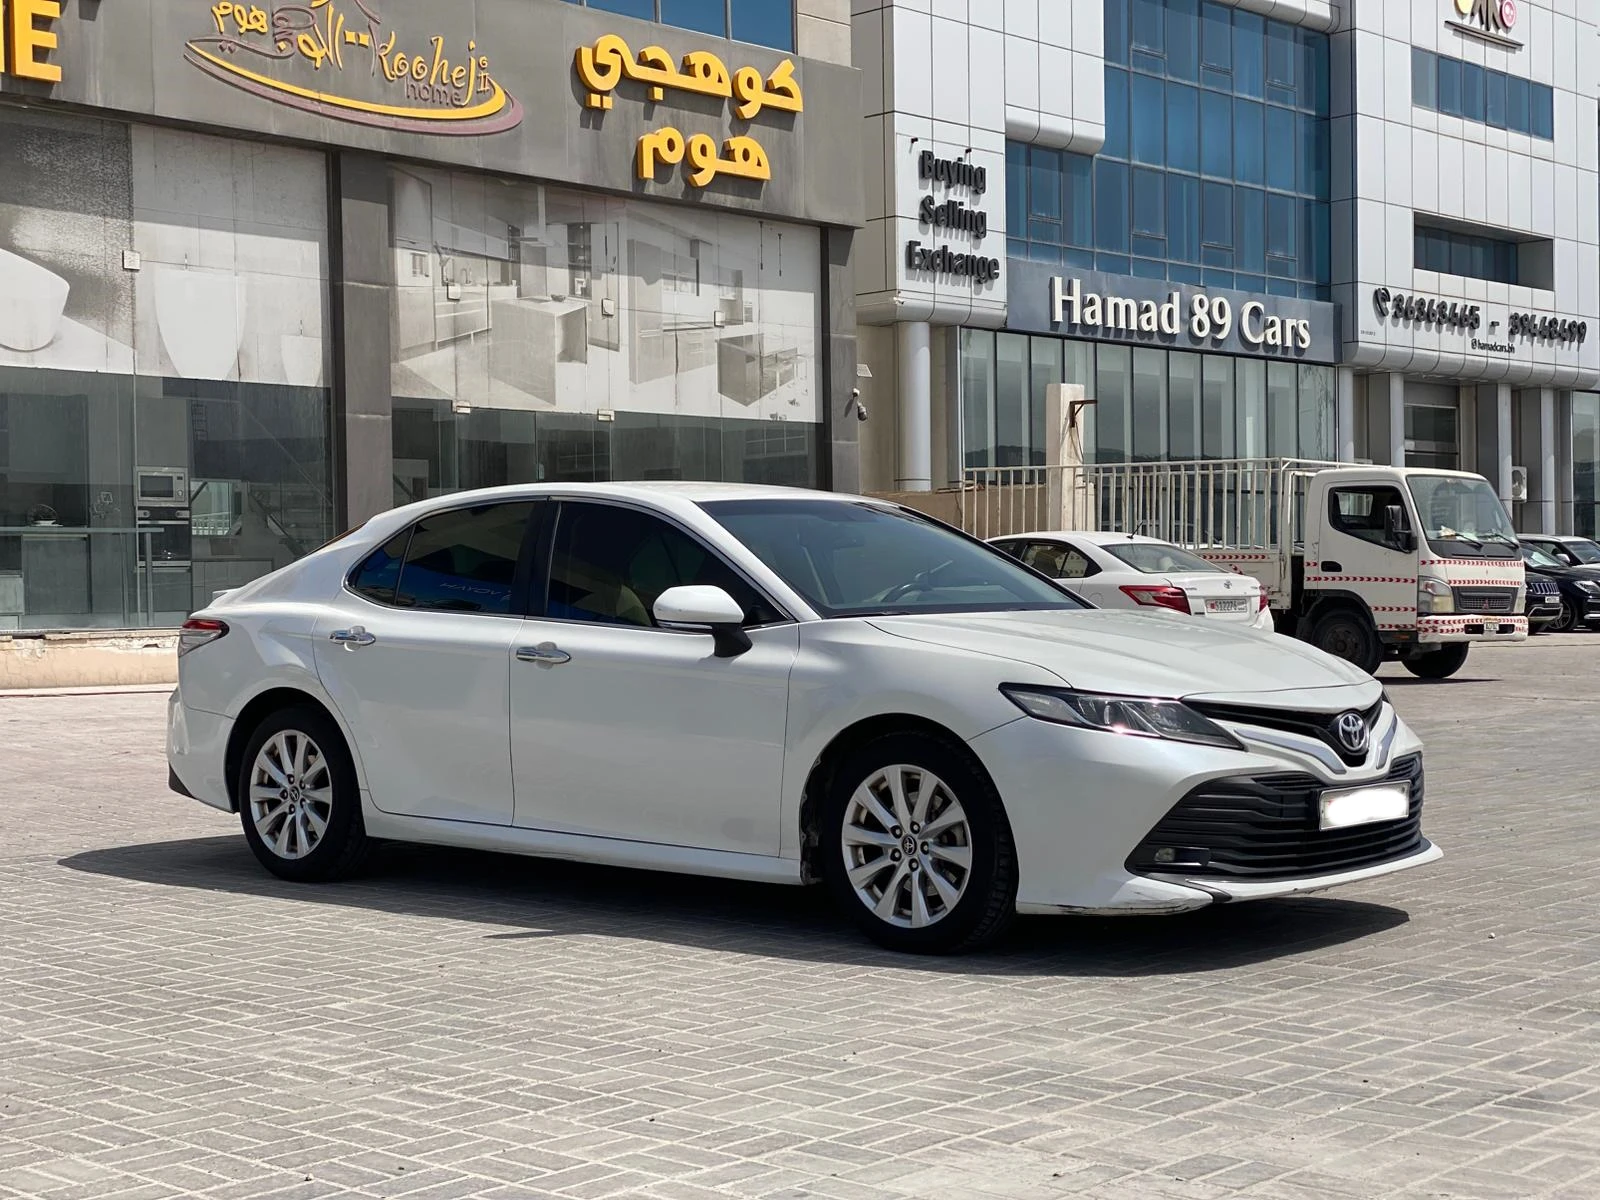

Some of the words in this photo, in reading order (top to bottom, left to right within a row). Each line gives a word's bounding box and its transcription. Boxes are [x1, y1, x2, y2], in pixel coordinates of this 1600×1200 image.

[405, 77, 464, 107] home
[575, 34, 803, 119] كوهجي
[637, 127, 771, 187] هوم
[919, 150, 986, 194] Buying
[919, 195, 987, 239] Selling
[907, 240, 1000, 284] Exchange
[1050, 276, 1181, 336] Hamad
[1190, 294, 1232, 341] 89
[1240, 301, 1311, 350] Cars
